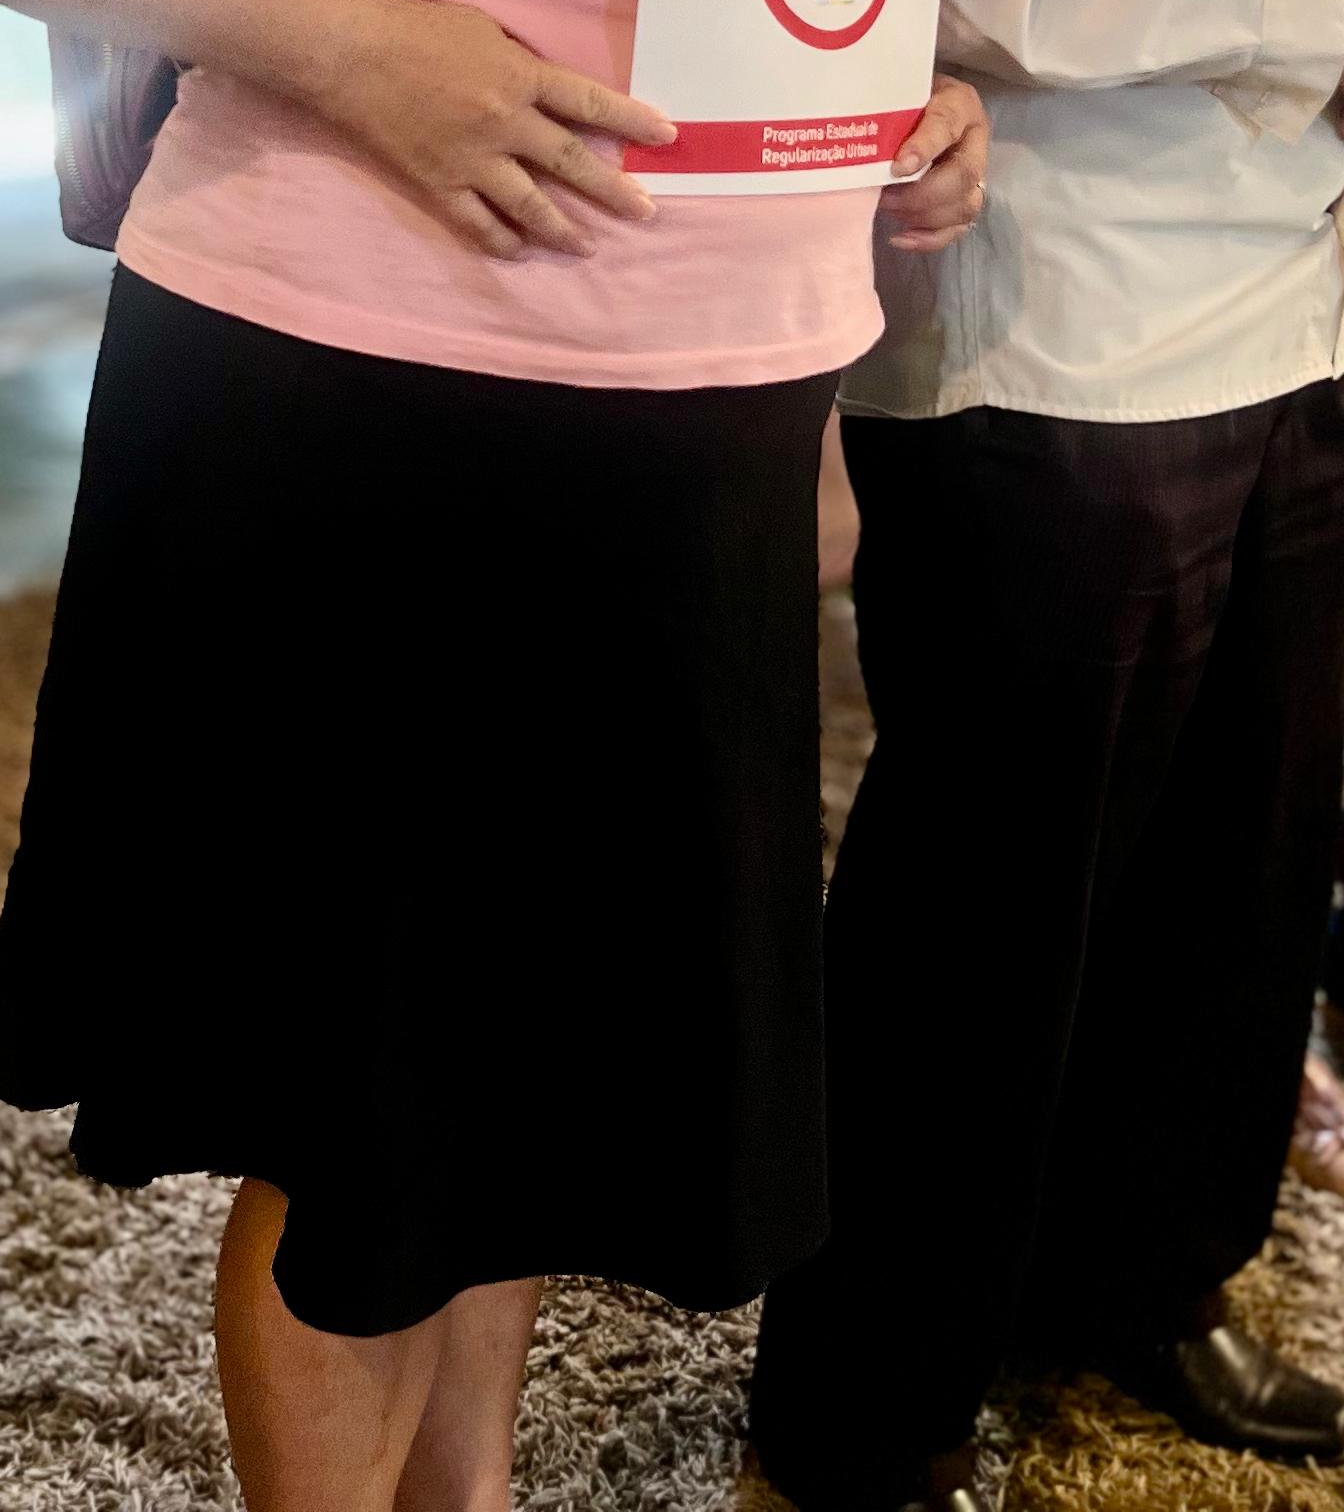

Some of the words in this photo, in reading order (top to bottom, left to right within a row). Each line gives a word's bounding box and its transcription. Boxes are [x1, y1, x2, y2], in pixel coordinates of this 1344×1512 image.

[762, 126, 824, 145] Programa
[825, 121, 869, 140] Estadual
[868, 120, 879, 136] de
[761, 143, 845, 167] Regularização
[846, 142, 877, 159] Urbana
